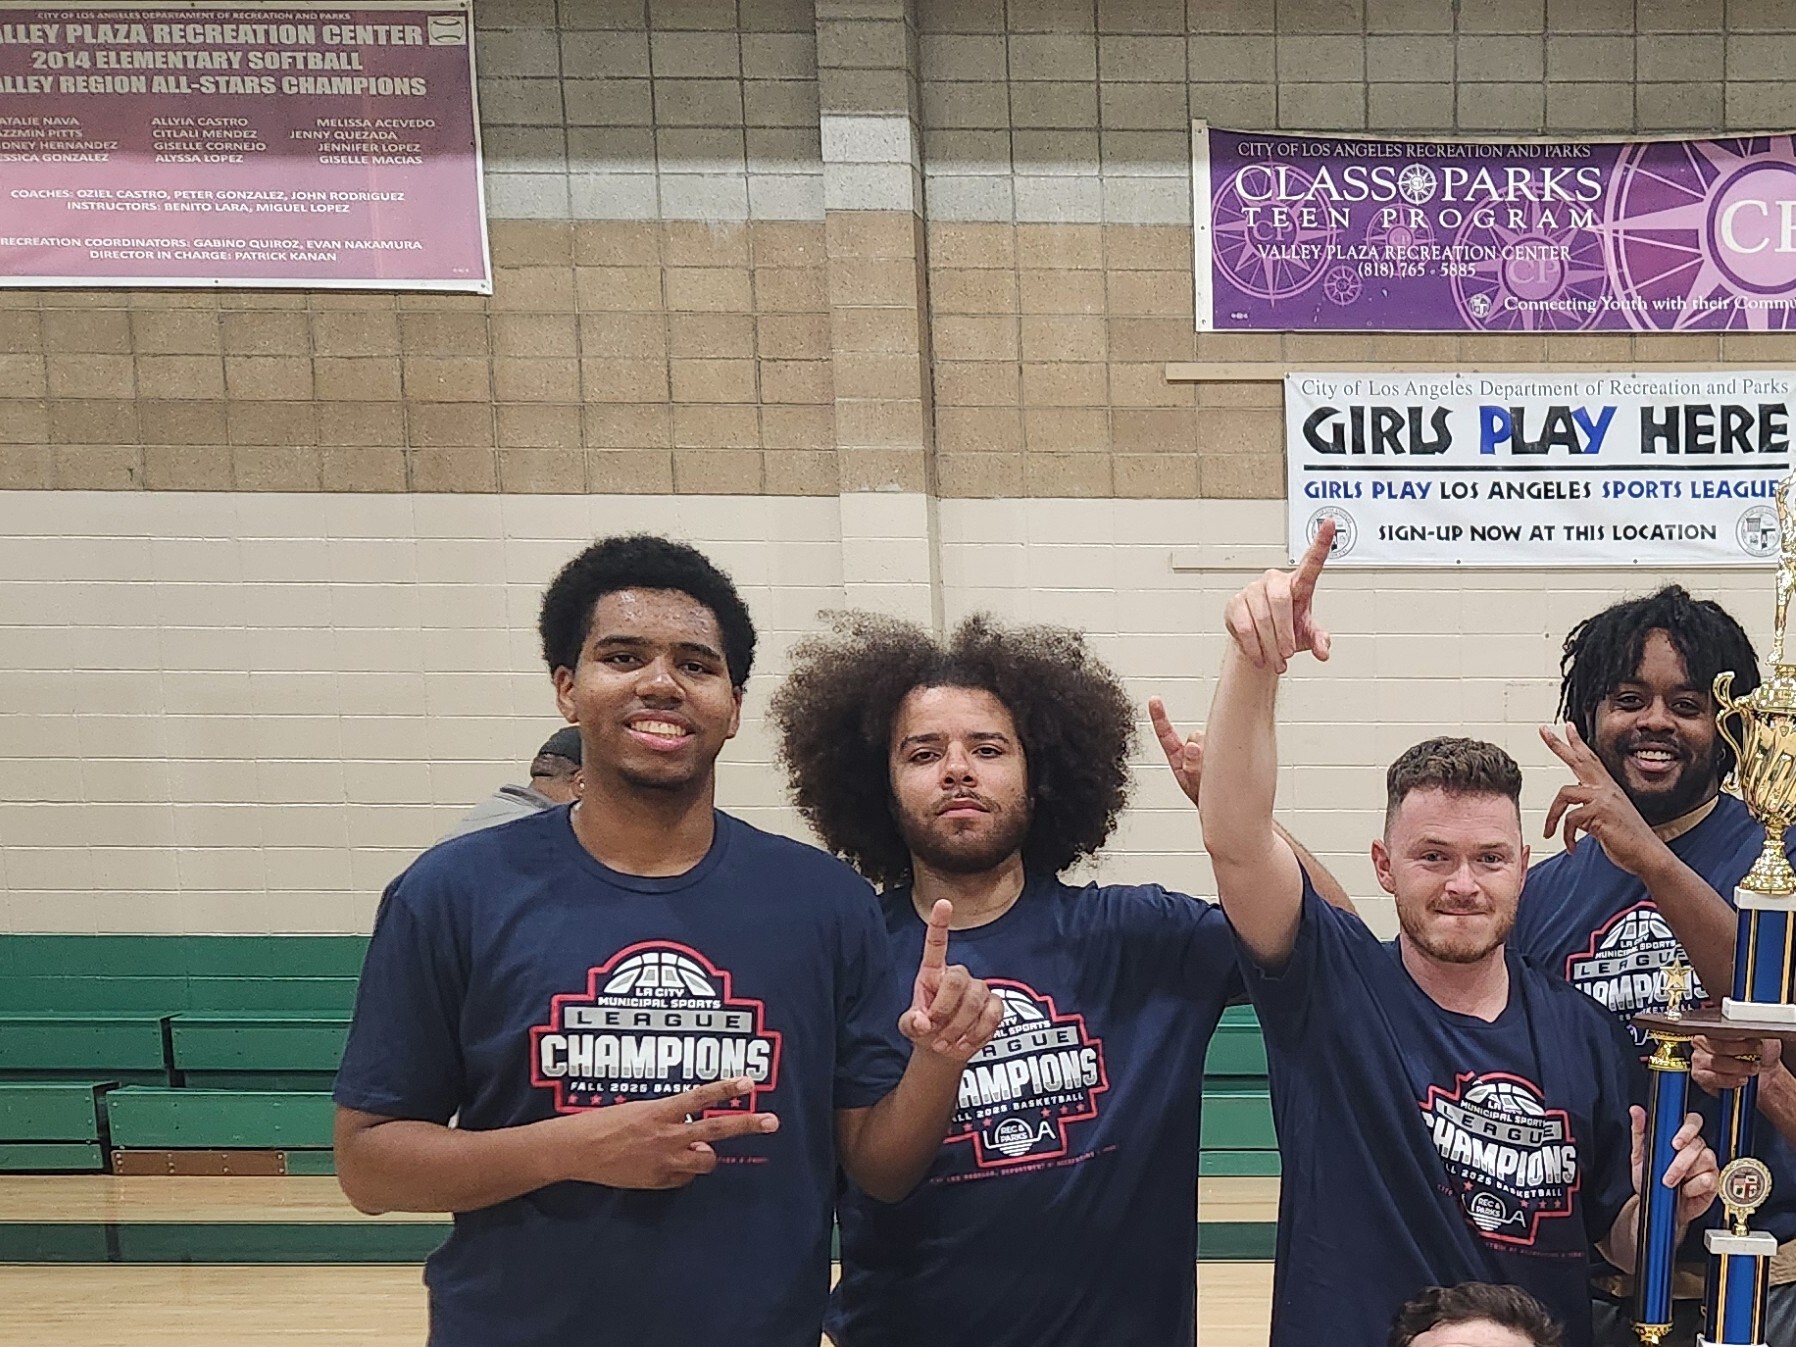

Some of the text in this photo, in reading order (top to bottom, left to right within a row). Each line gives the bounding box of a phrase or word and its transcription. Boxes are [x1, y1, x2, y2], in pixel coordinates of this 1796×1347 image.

[0, 24, 423, 45] LLEY PLAZA RECREATION CENTER
[31, 51, 363, 70] 2014 ELEMENTARY SOFTBALL
[0, 76, 426, 95] LLEY REGION ALL-STARS CHAMPIONS
[42, 117, 80, 126] NAVA
[152, 117, 248, 127] ALLYIA CASTRO
[317, 119, 435, 128] MELISSA ACEVEDO
[49, 129, 82, 138] PITTS
[152, 130, 258, 139] CITLALI MENDEZ
[290, 130, 398, 140] JENNY QUEZADA
[40, 141, 118, 150] HERNANDEZ
[154, 142, 267, 151] GISELLE CORNEJO
[318, 143, 421, 152] JENNIFER LOPEZ
[1238, 142, 1591, 158] CITY OF LOS ANGELES RECREATION AND PARKS
[42, 153, 109, 162] GONZALEZ
[155, 154, 244, 163] ALYSSA LOPEZ
[319, 155, 422, 165] GISELLE MACIAS
[1235, 164, 1602, 202] CLASS PARKS
[11, 189, 405, 202] COACHES: OZIEL CASTRO, PETER GONZALEZ, JOHN RODRIGUEZ
[67, 202, 350, 214] INSTRUCTORS: BENITO LARA, MIGUEL LOPEZ
[1241, 206, 1595, 229] TEEN PROGRAM
[0, 238, 423, 250] RECREATION COORDINATORS: GABINO QUIROZ, EVAN NAKAMURA
[90, 250, 337, 261] DIRECTOR IN CHARGE: PATRICK KANAN
[1257, 244, 1572, 261] VALLEY PLAZA RECREATION CENTER
[1358, 262, 1476, 278] (818) 765 5885
[1504, 296, 1597, 313] Connecting
[1601, 295, 1648, 311] Youth
[1651, 296, 1689, 311] with
[1693, 296, 1730, 311] their
[1301, 379, 1789, 400] City of Los Angeles Department of Recreation and Parks
[1302, 403, 1790, 456] GIRLS PLAY HERE
[1304, 479, 1782, 500] GIRLS PLAY LOS ANGELES SPORTS LEAGUE
[1378, 524, 1717, 542] SIGN-UP NOW AT THIS LOCATION
[656, 988, 685, 998] CITY
[598, 997, 721, 1009] MUNICIPAL SPORTS
[576, 1010, 742, 1029] LEAGUE
[540, 1034, 771, 1082] CHAMPIONS
[956, 1048, 1098, 1110] AMPIONS
